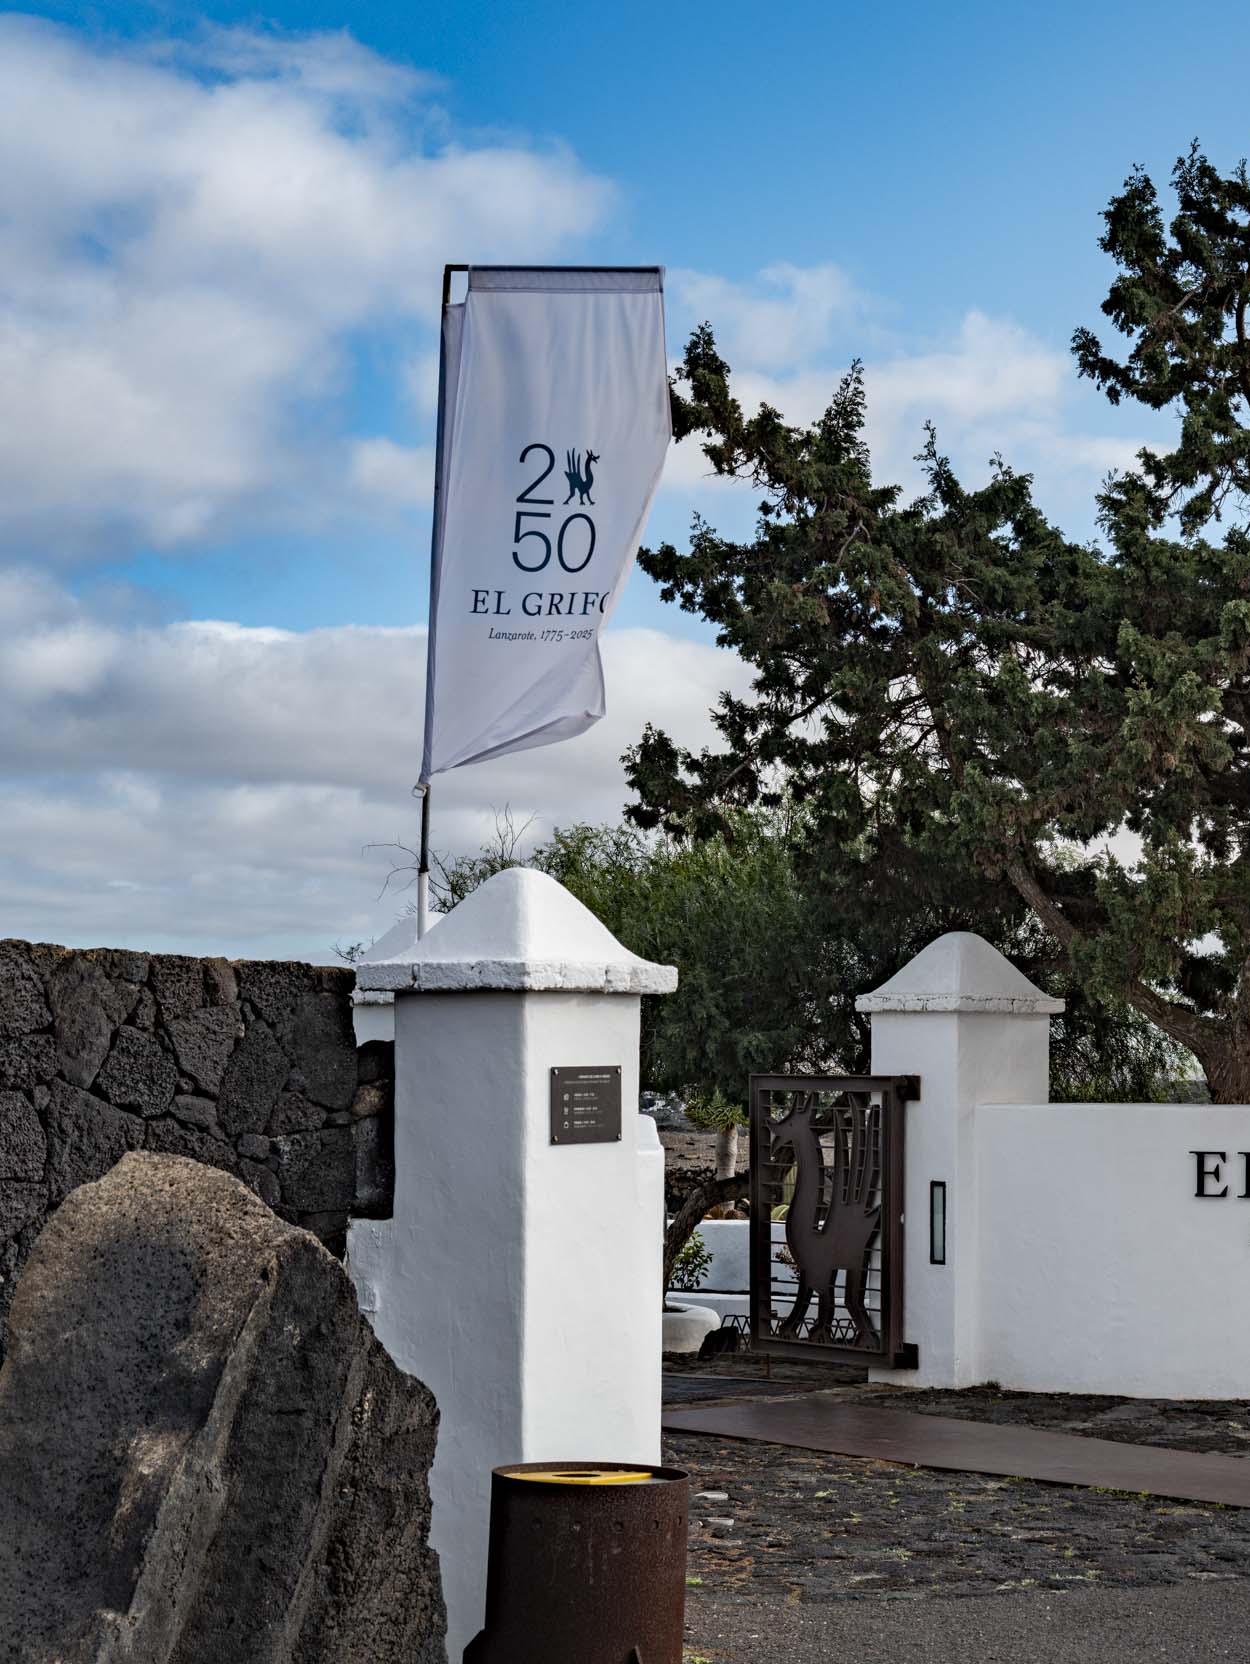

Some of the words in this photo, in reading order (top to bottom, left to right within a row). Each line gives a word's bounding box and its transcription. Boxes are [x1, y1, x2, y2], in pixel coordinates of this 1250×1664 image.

[512, 511, 597, 573] 50
[469, 589, 511, 615] EL
[488, 627, 537, 641] Lanzarote,
